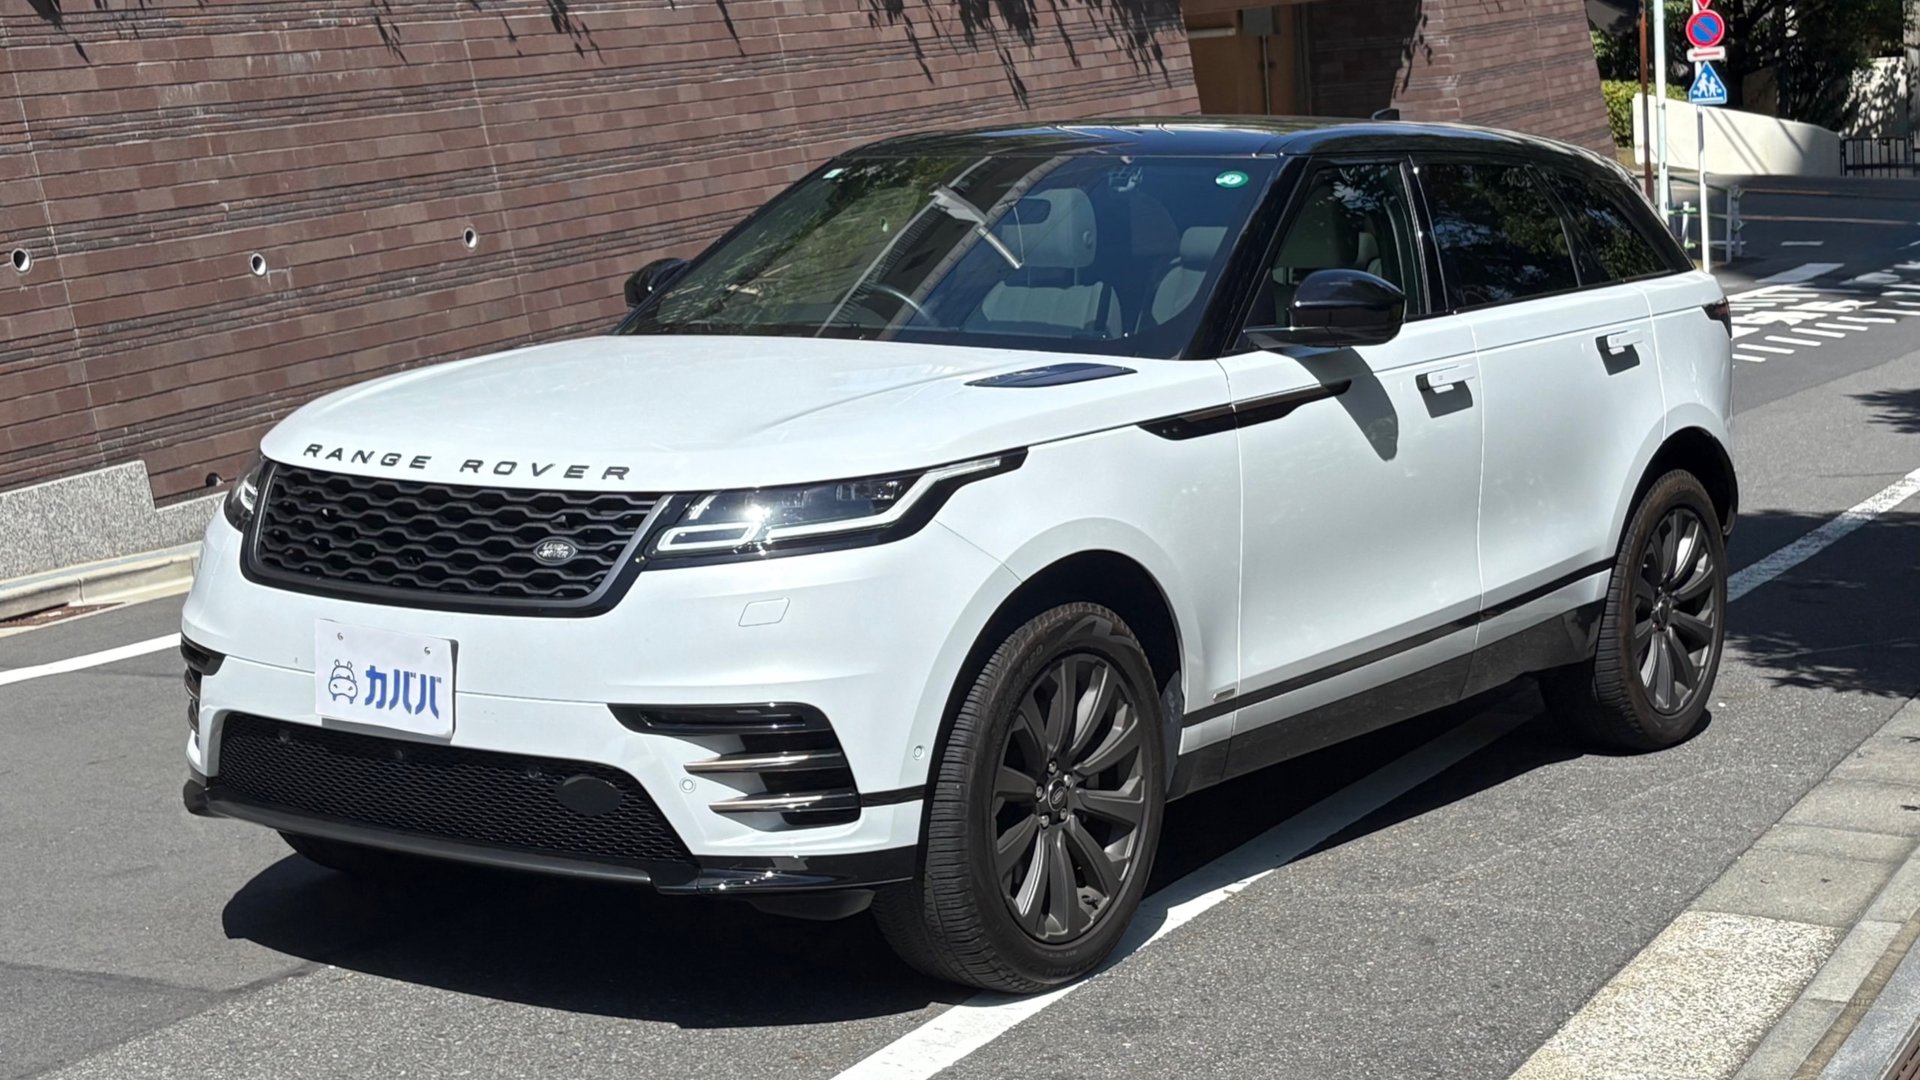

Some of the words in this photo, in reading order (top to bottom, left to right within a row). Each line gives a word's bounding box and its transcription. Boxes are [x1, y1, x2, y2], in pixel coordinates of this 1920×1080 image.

[303, 443, 432, 470] RANGE
[459, 459, 631, 481] ROVER
[364, 665, 442, 719] カババ
